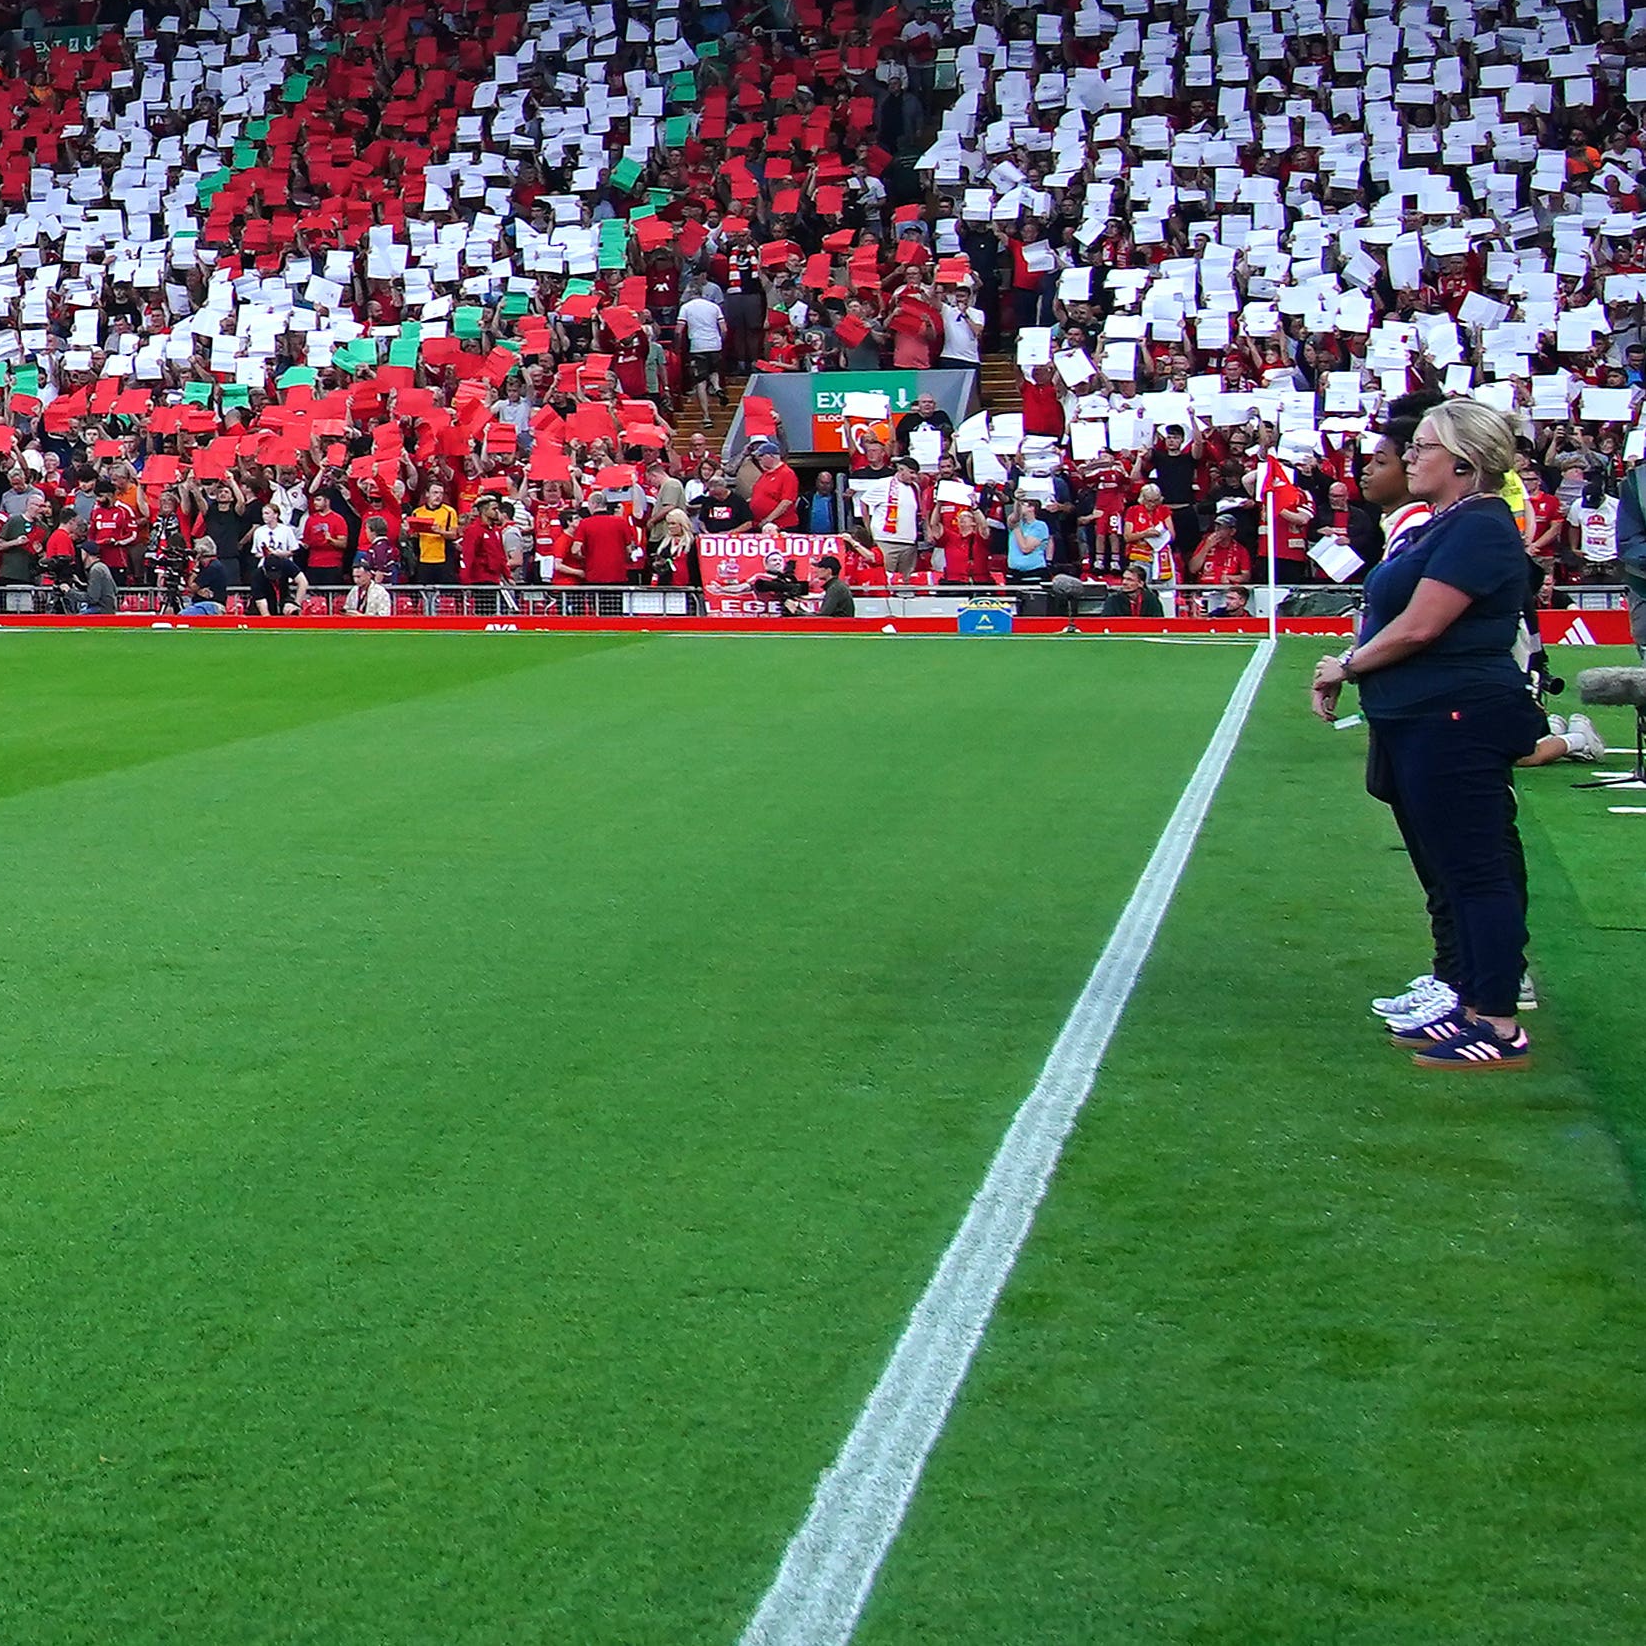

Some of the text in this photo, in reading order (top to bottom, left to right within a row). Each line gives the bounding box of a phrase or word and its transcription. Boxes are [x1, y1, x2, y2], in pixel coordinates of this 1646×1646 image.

[33, 40, 62, 53] EXT
[700, 537, 839, 557] DIOGO JOTA
